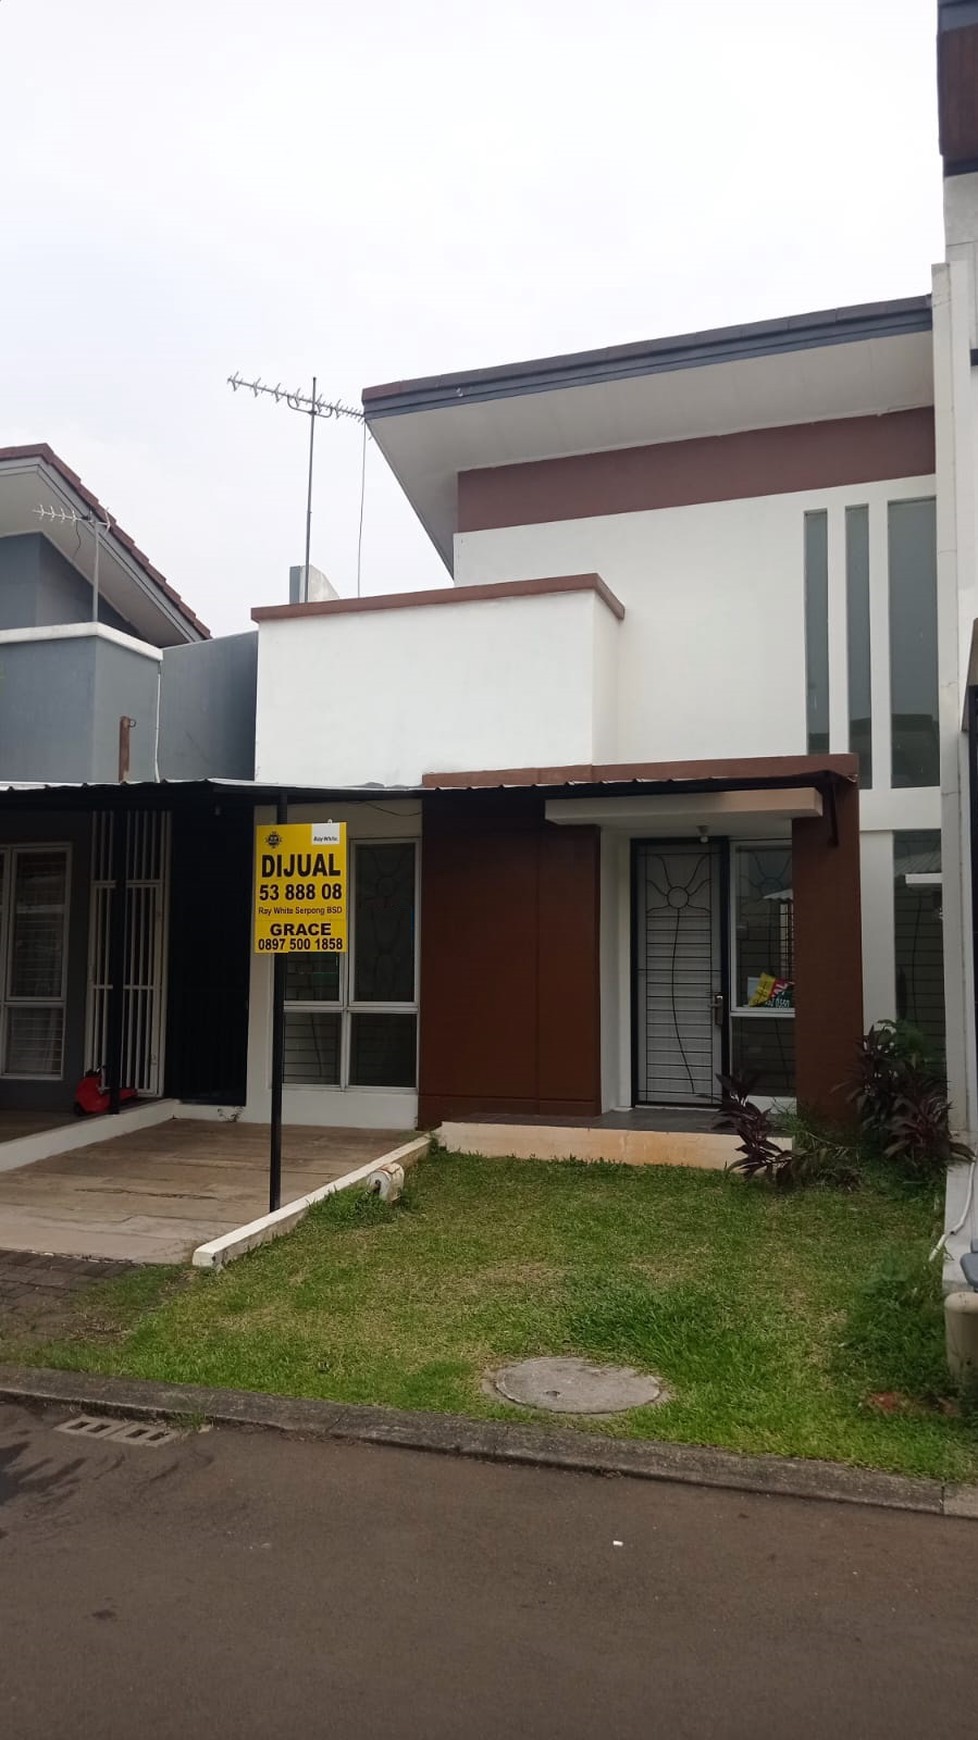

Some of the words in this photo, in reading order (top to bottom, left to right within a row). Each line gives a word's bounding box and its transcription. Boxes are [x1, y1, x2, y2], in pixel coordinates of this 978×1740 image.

[261, 853, 341, 878] DIJUAL
[259, 884, 279, 901] 53
[285, 883, 316, 900] 888
[321, 883, 342, 900] 08
[258, 906, 271, 916] Ray
[274, 906, 293, 915] White
[295, 906, 325, 915] Serpong
[326, 906, 343, 914] BSD
[269, 923, 332, 936] GRACE
[258, 938, 286, 950] 0897
[289, 938, 311, 950] 500
[315, 938, 343, 950] 1858
